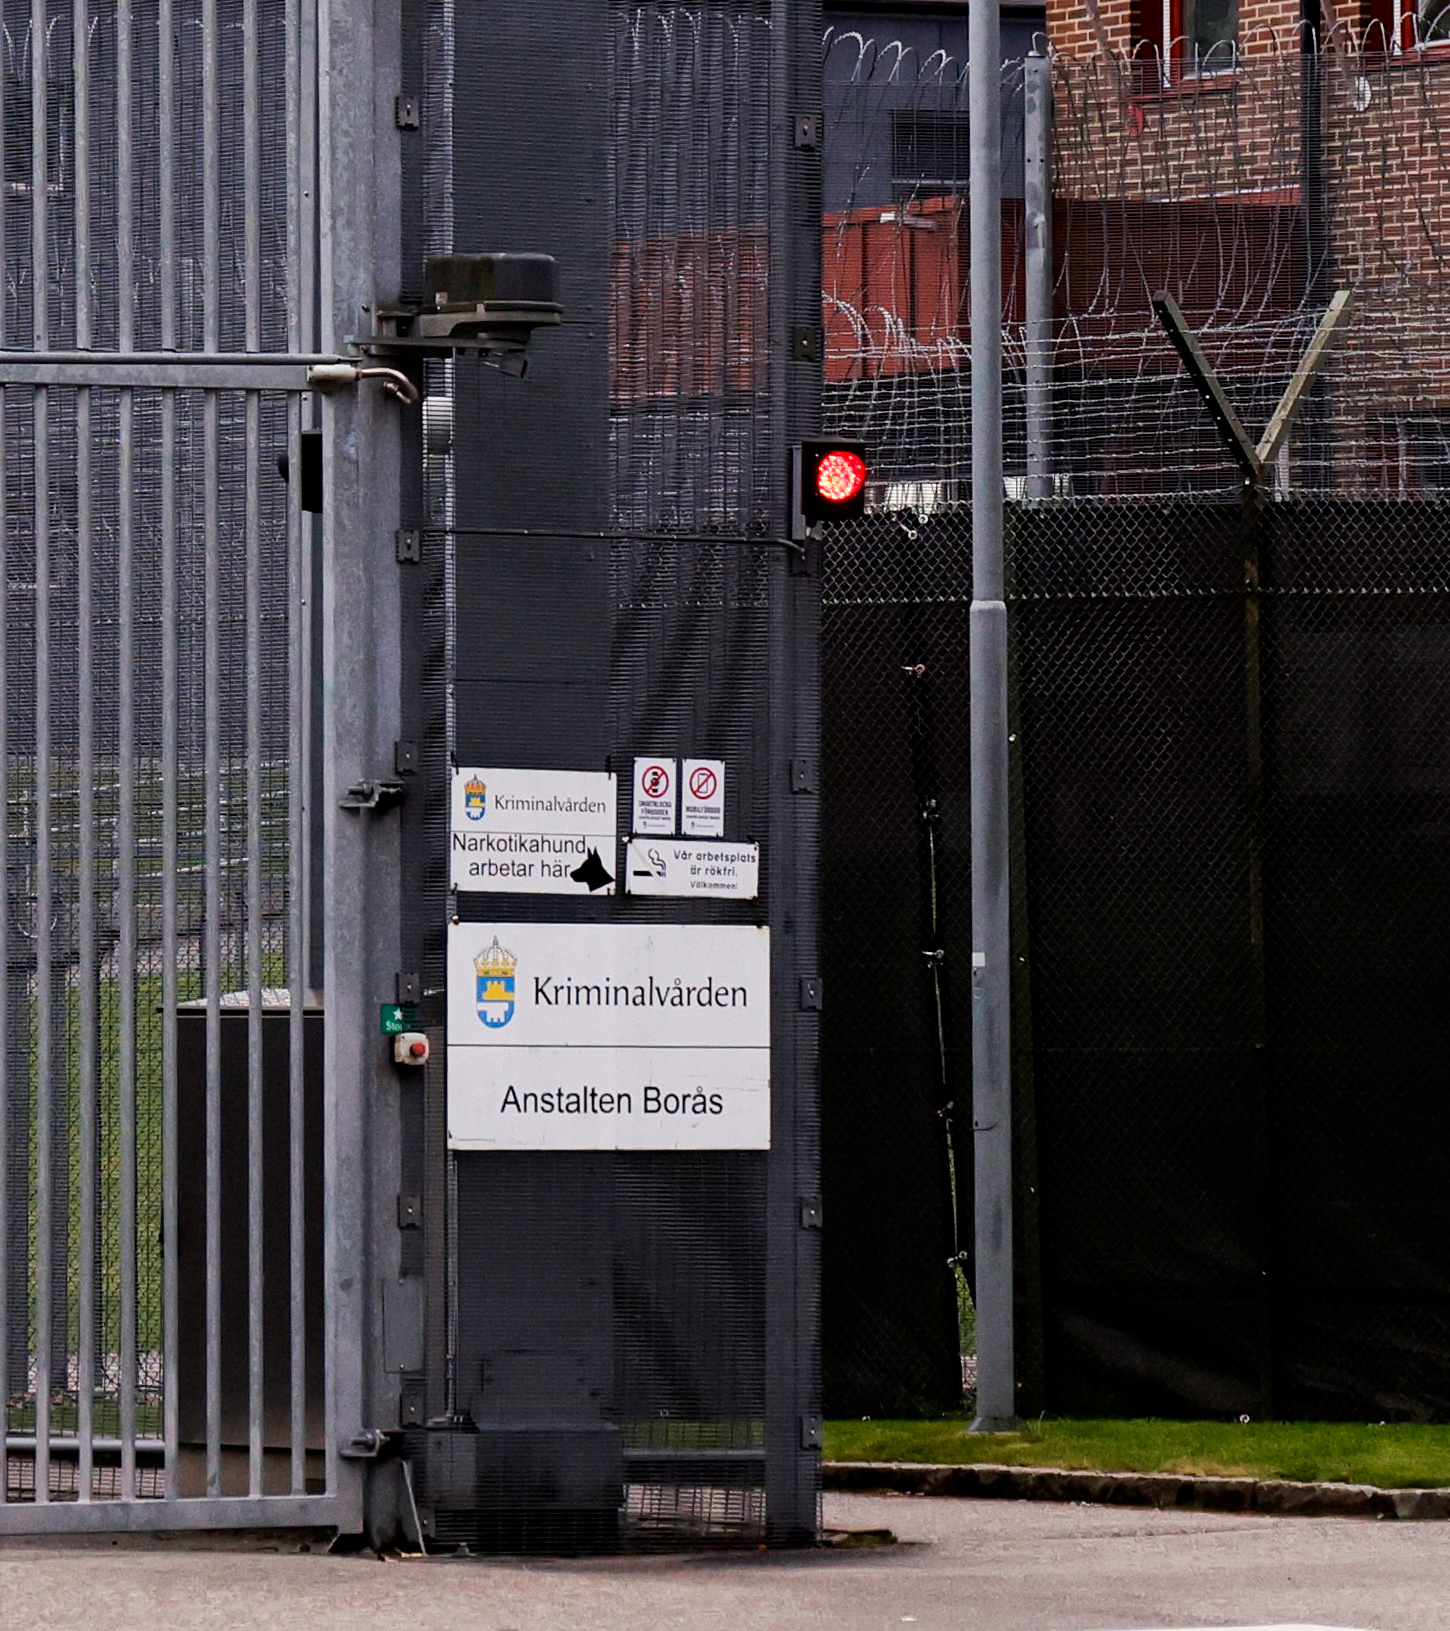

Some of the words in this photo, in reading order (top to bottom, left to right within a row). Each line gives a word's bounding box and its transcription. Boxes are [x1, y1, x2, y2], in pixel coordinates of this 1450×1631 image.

[494, 795, 606, 813] Kriminalvården
[452, 834, 586, 854] Narkotikahund
[673, 849, 693, 861] Vår
[696, 851, 757, 864] arbetsplats
[469, 859, 534, 877] arbetar
[541, 860, 571, 879] här
[690, 865, 701, 875] är
[534, 976, 747, 1007] Kriminalvården
[500, 1085, 632, 1114] Anstalten
[643, 1086, 724, 1115] Borås
